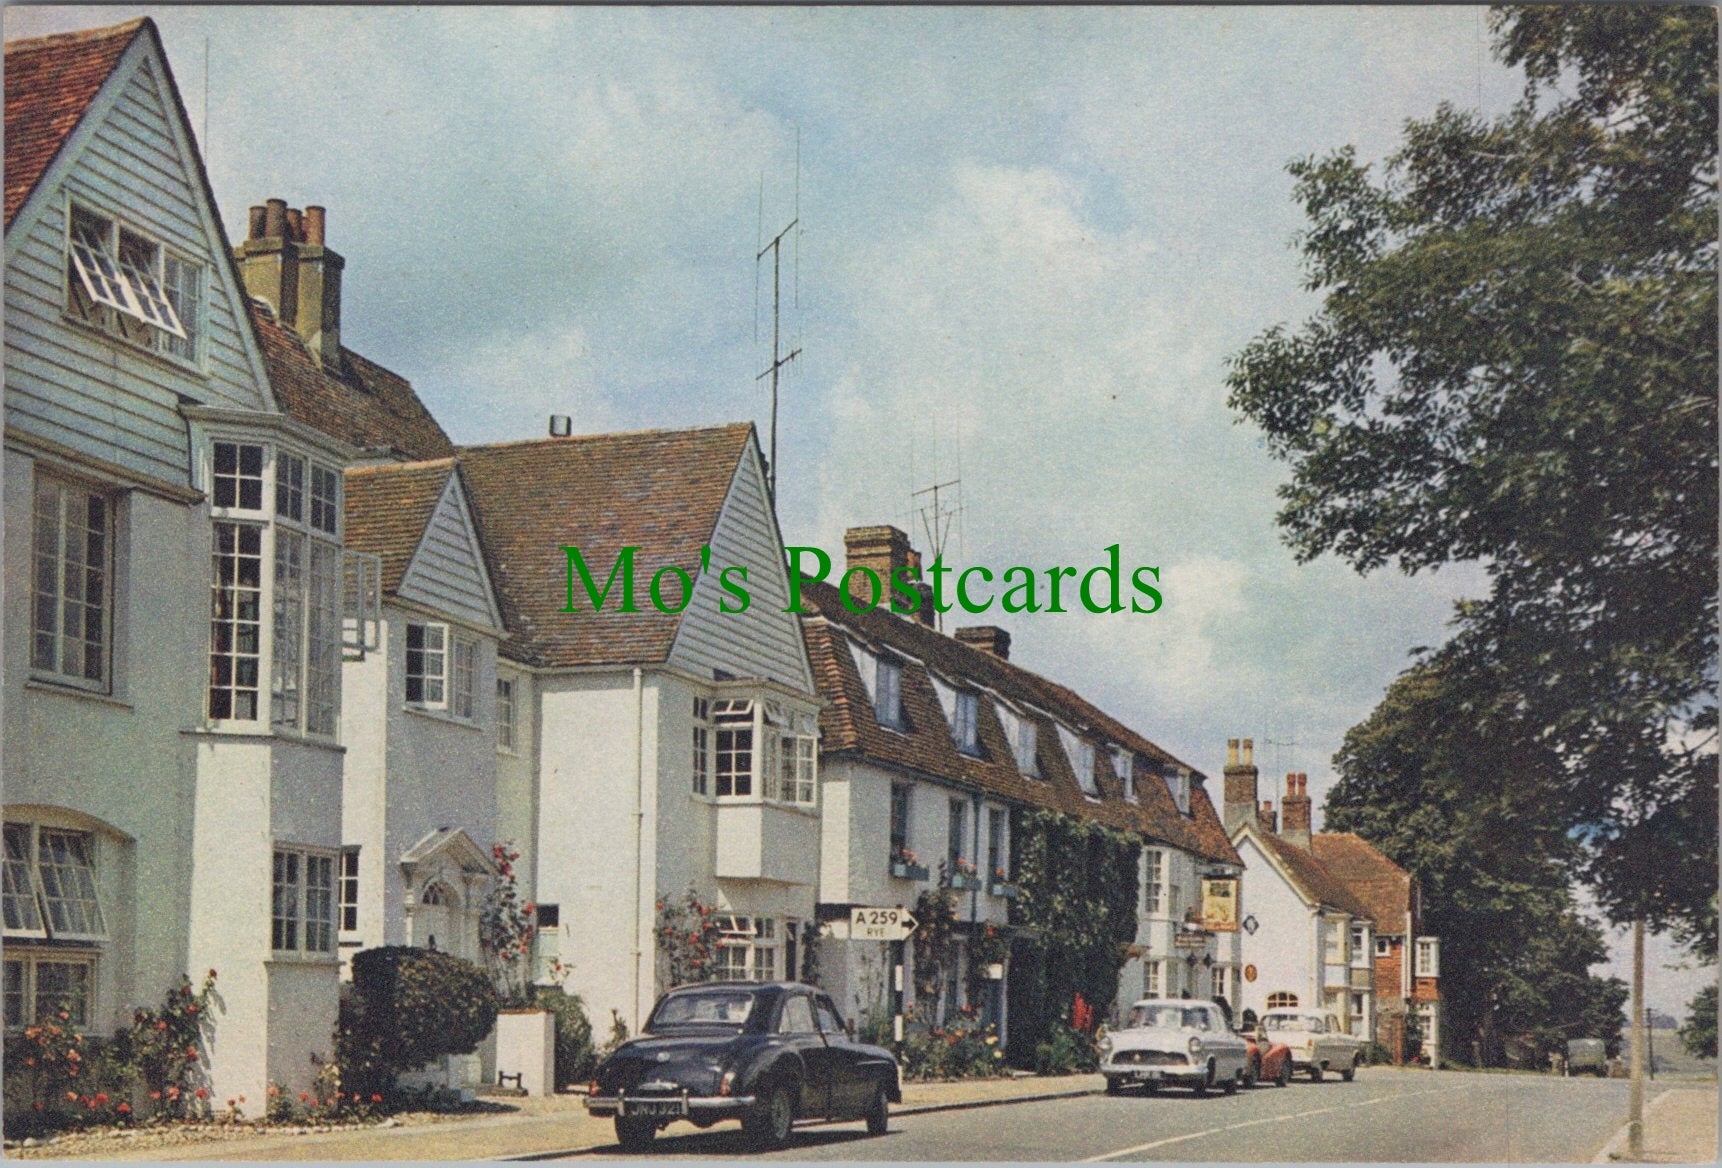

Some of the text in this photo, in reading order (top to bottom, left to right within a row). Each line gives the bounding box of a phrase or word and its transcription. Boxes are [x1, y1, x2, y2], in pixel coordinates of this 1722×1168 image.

[856, 911, 898, 925] A 259
[866, 927, 886, 937] RYE
